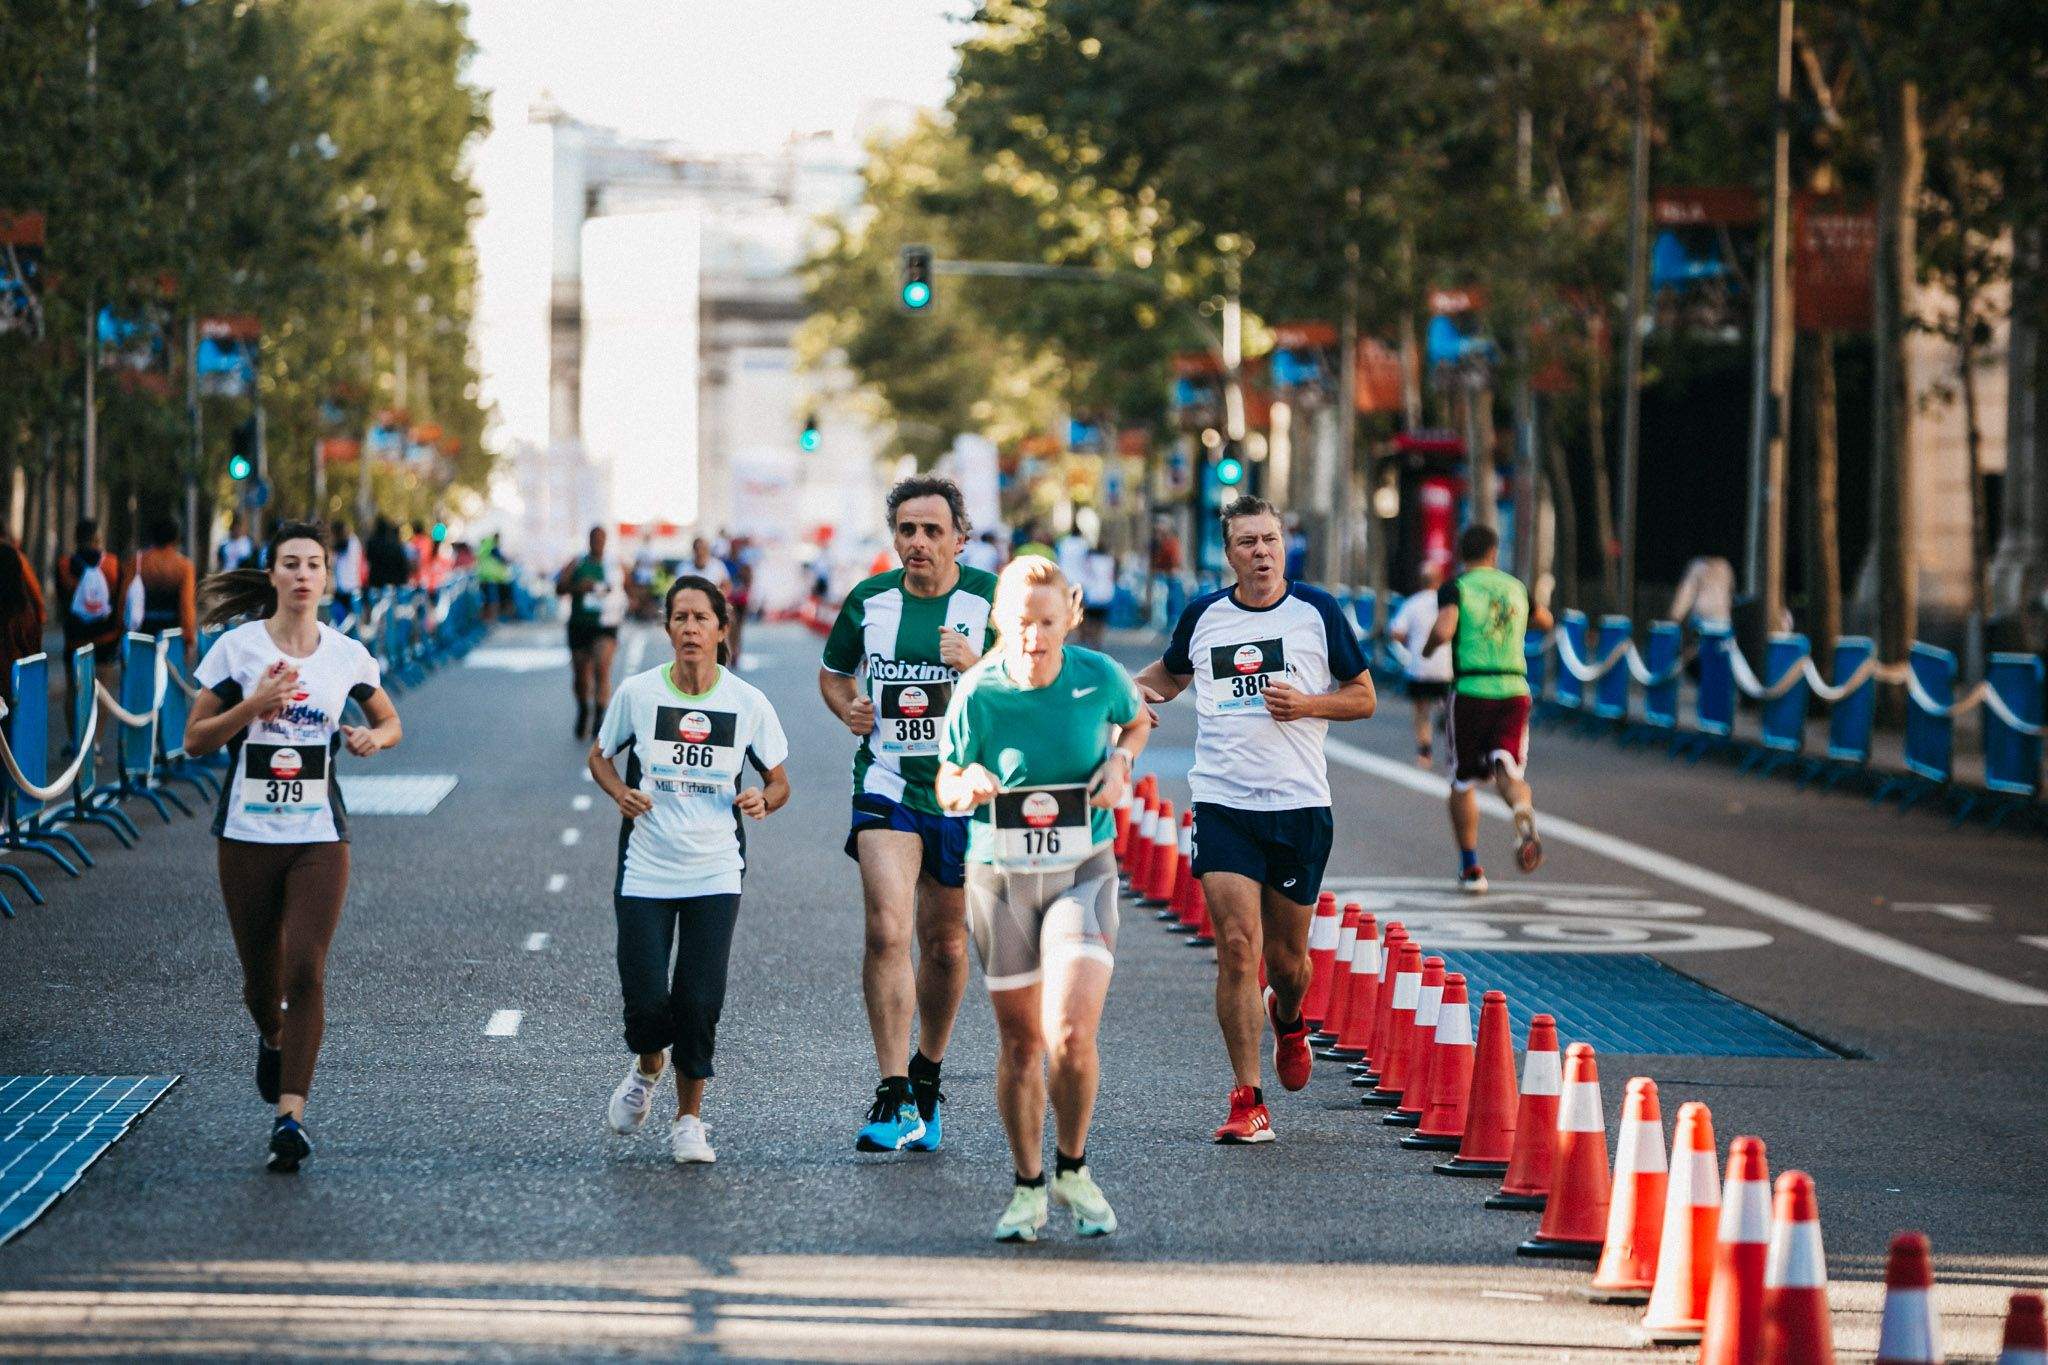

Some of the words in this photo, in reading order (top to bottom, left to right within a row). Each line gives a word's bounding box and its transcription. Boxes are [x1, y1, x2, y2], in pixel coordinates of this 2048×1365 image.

[1232, 674, 1270, 698] 380
[895, 719, 936, 742] 389
[672, 743, 714, 768] 366
[266, 781, 303, 803] 379
[1023, 829, 1060, 855] 176
